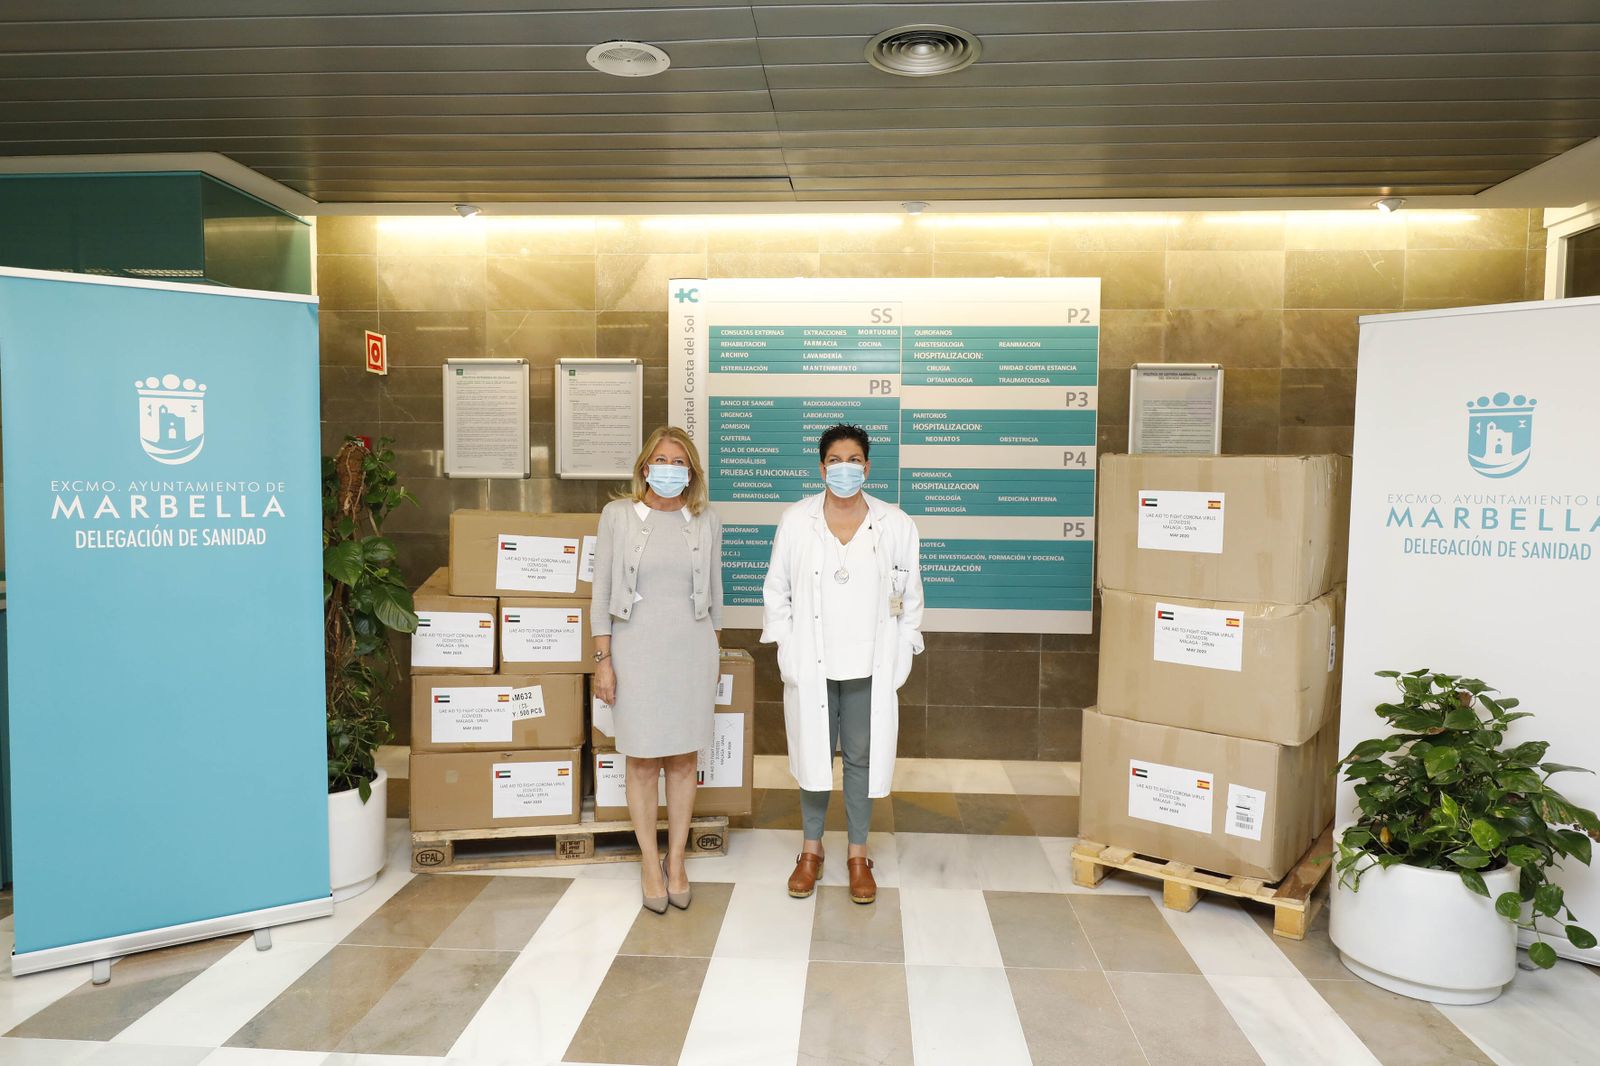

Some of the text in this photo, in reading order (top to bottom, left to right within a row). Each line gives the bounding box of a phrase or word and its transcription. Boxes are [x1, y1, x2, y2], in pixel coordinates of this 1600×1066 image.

[871, 308, 893, 323] SS
[1067, 308, 1090, 323] P2
[684, 316, 696, 440] ospital Costa del Sol
[869, 380, 892, 394] PB
[1066, 392, 1088, 407] P3
[1064, 452, 1086, 466] P4
[51, 481, 285, 492] EXCMO. AYUNTAMIENTO DE
[51, 495, 286, 519] MARBELLA
[1387, 494, 1447, 504] EXCMO.
[1453, 494, 1588, 506] AYUNTAMIENTO
[75, 524, 266, 548] DELEGACIÓN DE SANIDAD
[1063, 522, 1085, 537] P5
[1404, 536, 1592, 560] DELEGACIÓN DE SANIDAD
[702, 838, 720, 847] EPAL
[420, 853, 440, 863] EPAL
